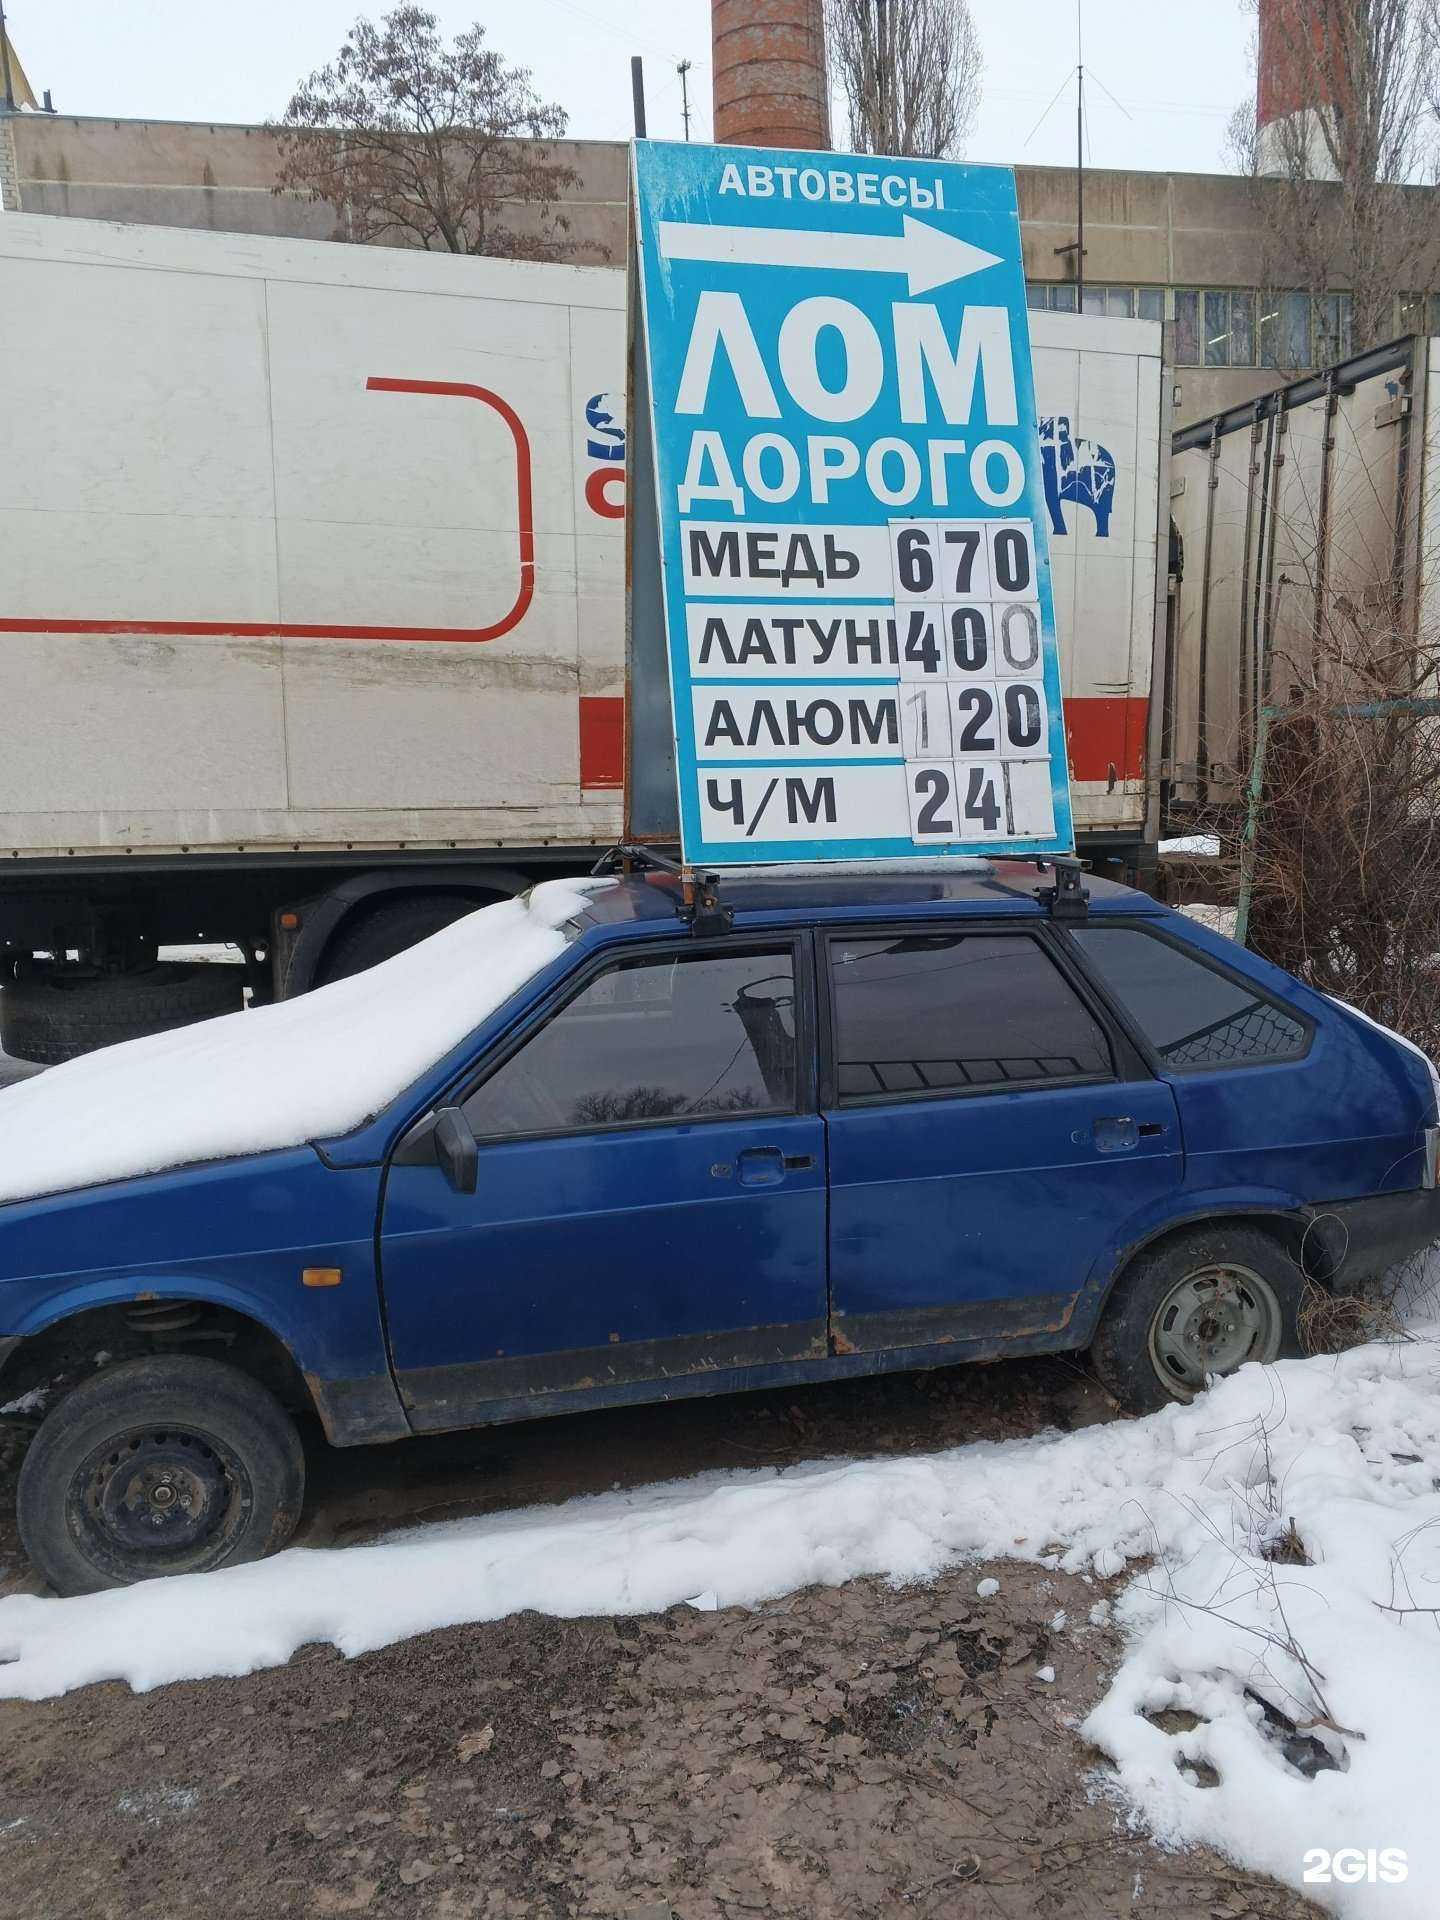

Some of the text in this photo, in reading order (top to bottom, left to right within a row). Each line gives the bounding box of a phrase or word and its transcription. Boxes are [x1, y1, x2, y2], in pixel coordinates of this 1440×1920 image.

[718, 163, 945, 210] АВТОВЕСЫ
[674, 290, 1019, 426] ЛОМ
[677, 430, 1026, 516] ДОРОГО
[688, 527, 1031, 594] МЕДЬ 670
[904, 603, 1039, 674] 400
[704, 683, 1042, 752] АЛЮМ 120
[706, 776, 838, 837] Ч/М
